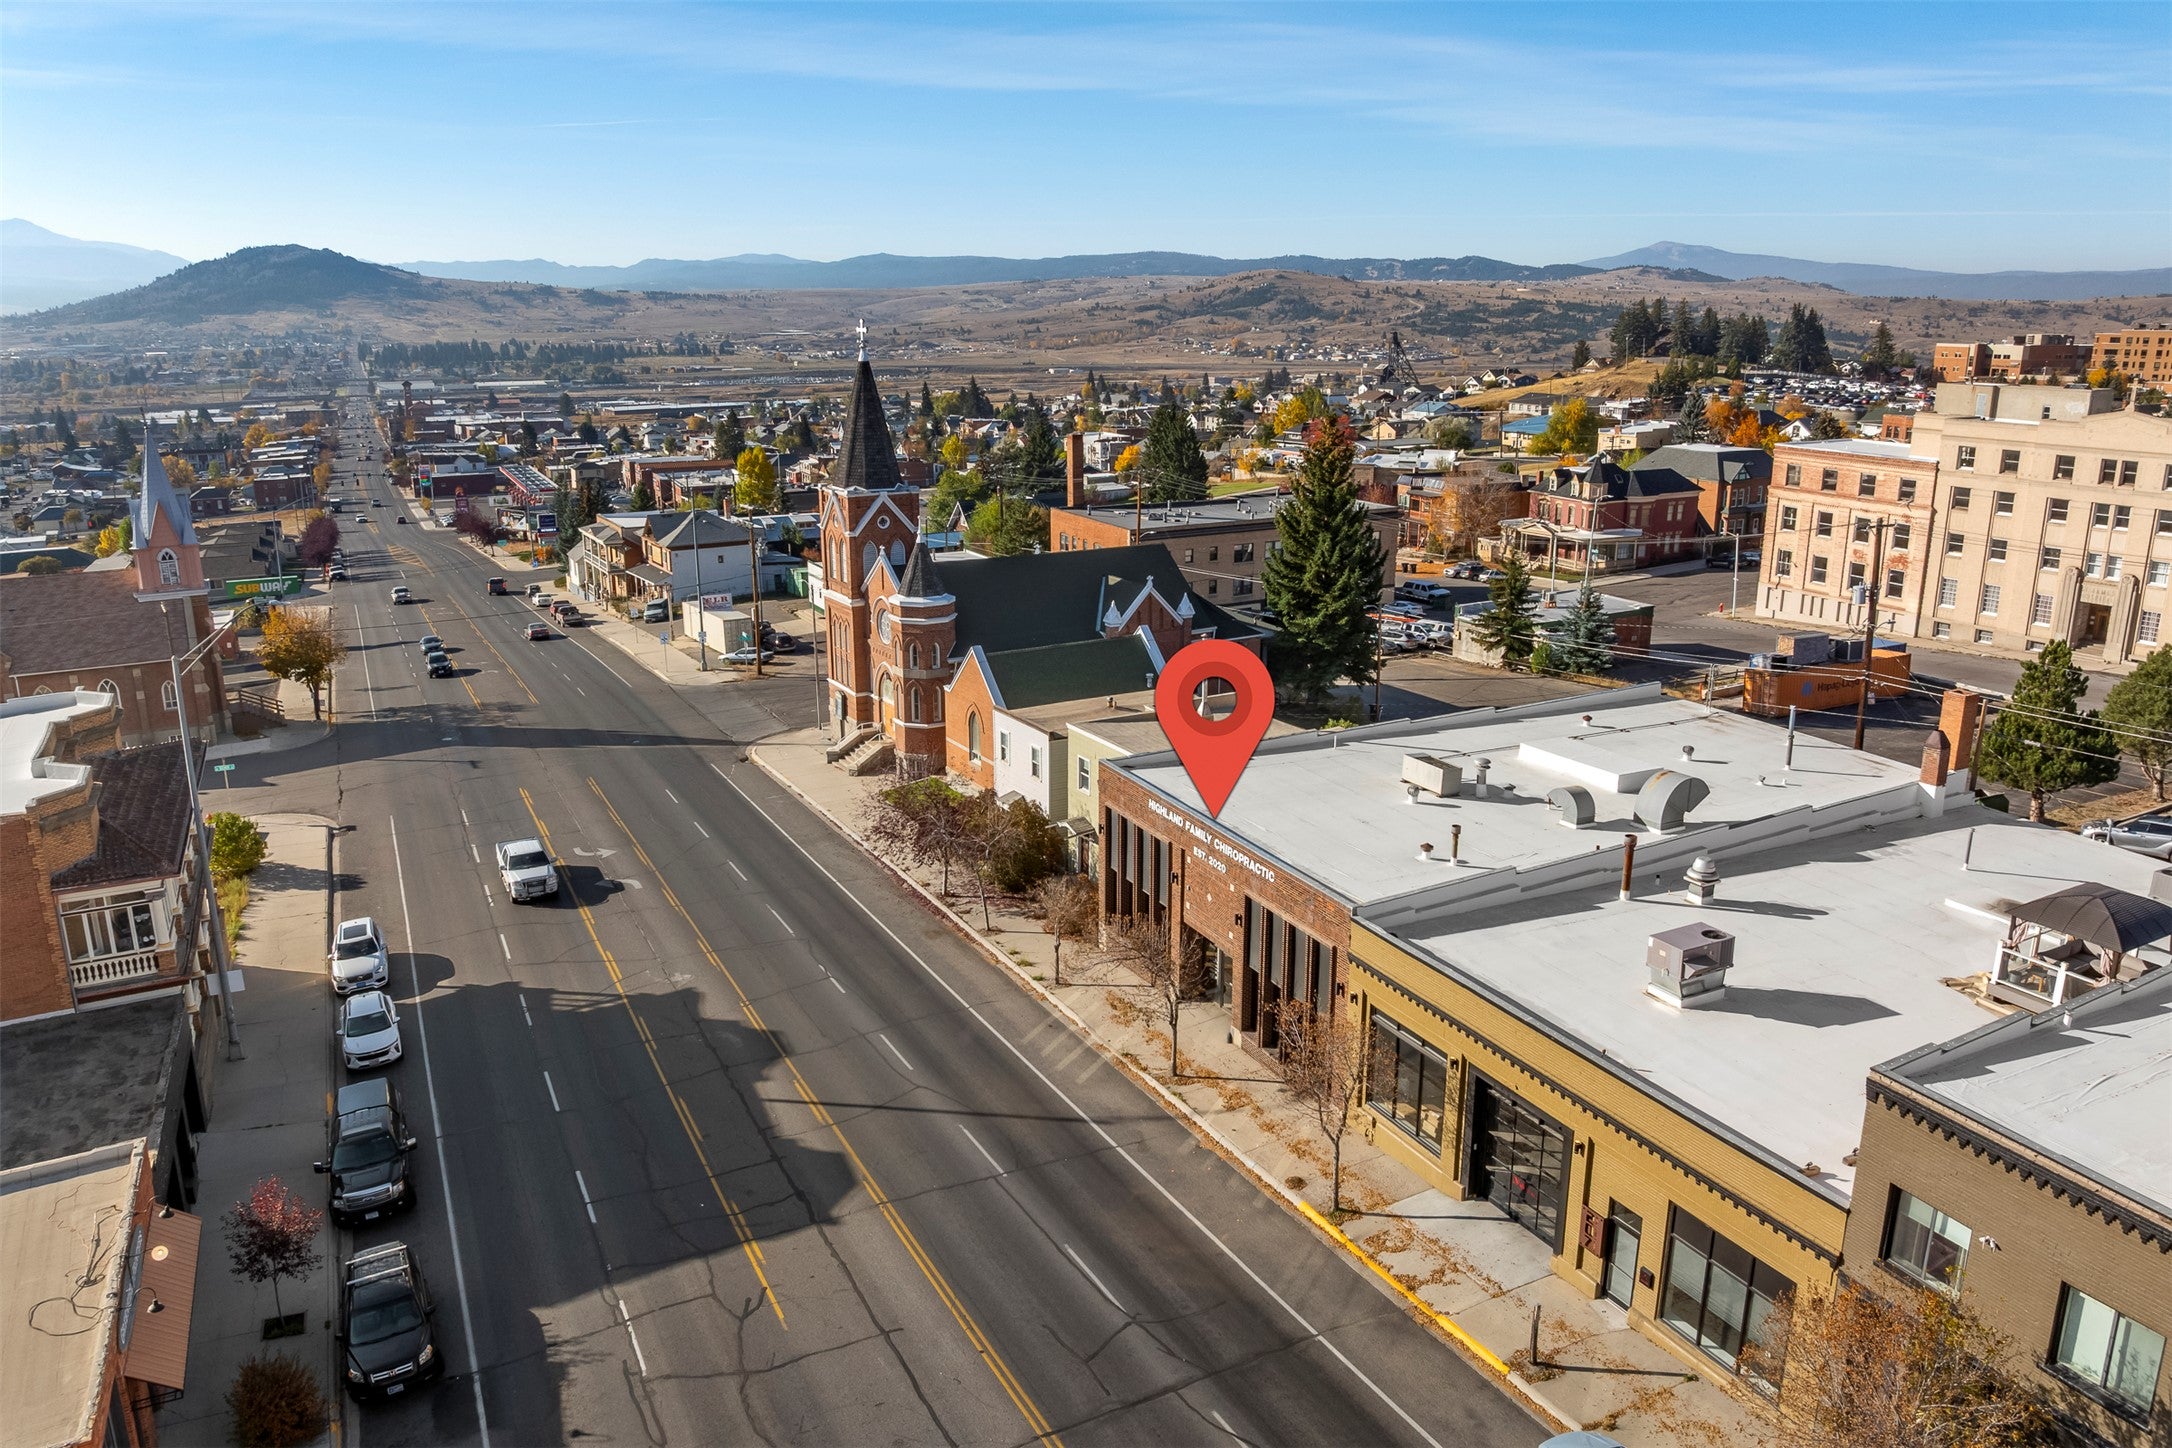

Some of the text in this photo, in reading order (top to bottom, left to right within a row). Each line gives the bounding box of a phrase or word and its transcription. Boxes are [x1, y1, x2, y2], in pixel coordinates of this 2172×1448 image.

[1148, 799, 1276, 883] HIGHLAND FAMILY CHIROPRACTIC
[1193, 846, 1227, 875] EST. 2020
